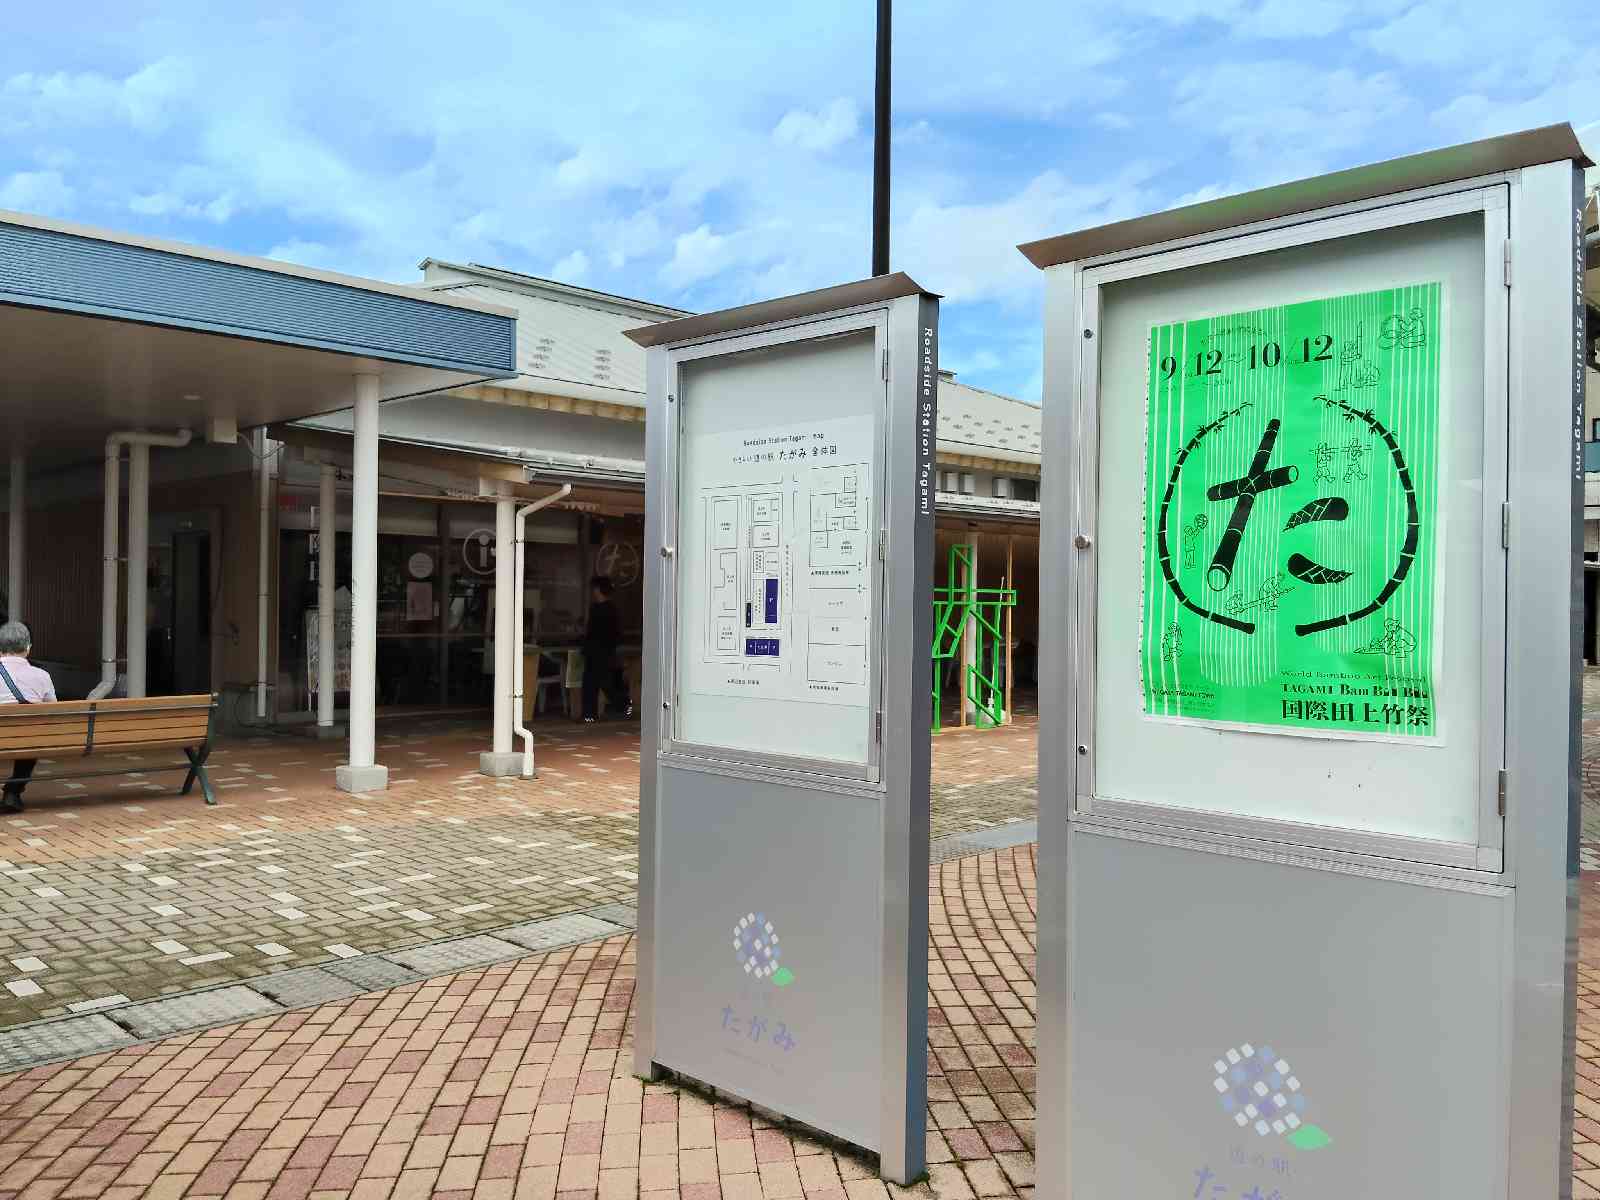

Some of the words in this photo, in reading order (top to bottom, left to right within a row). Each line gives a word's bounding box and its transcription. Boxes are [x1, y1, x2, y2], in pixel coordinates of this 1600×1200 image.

[1575, 207, 1584, 306] Roadside
[923, 327, 933, 396] Roadside
[1575, 315, 1584, 394] Station
[921, 403, 932, 456] Station
[920, 462, 931, 515] Tagami
[1280, 682, 1334, 695] TAGAMI
[1281, 699, 1431, 727] 国際田上竹祭
